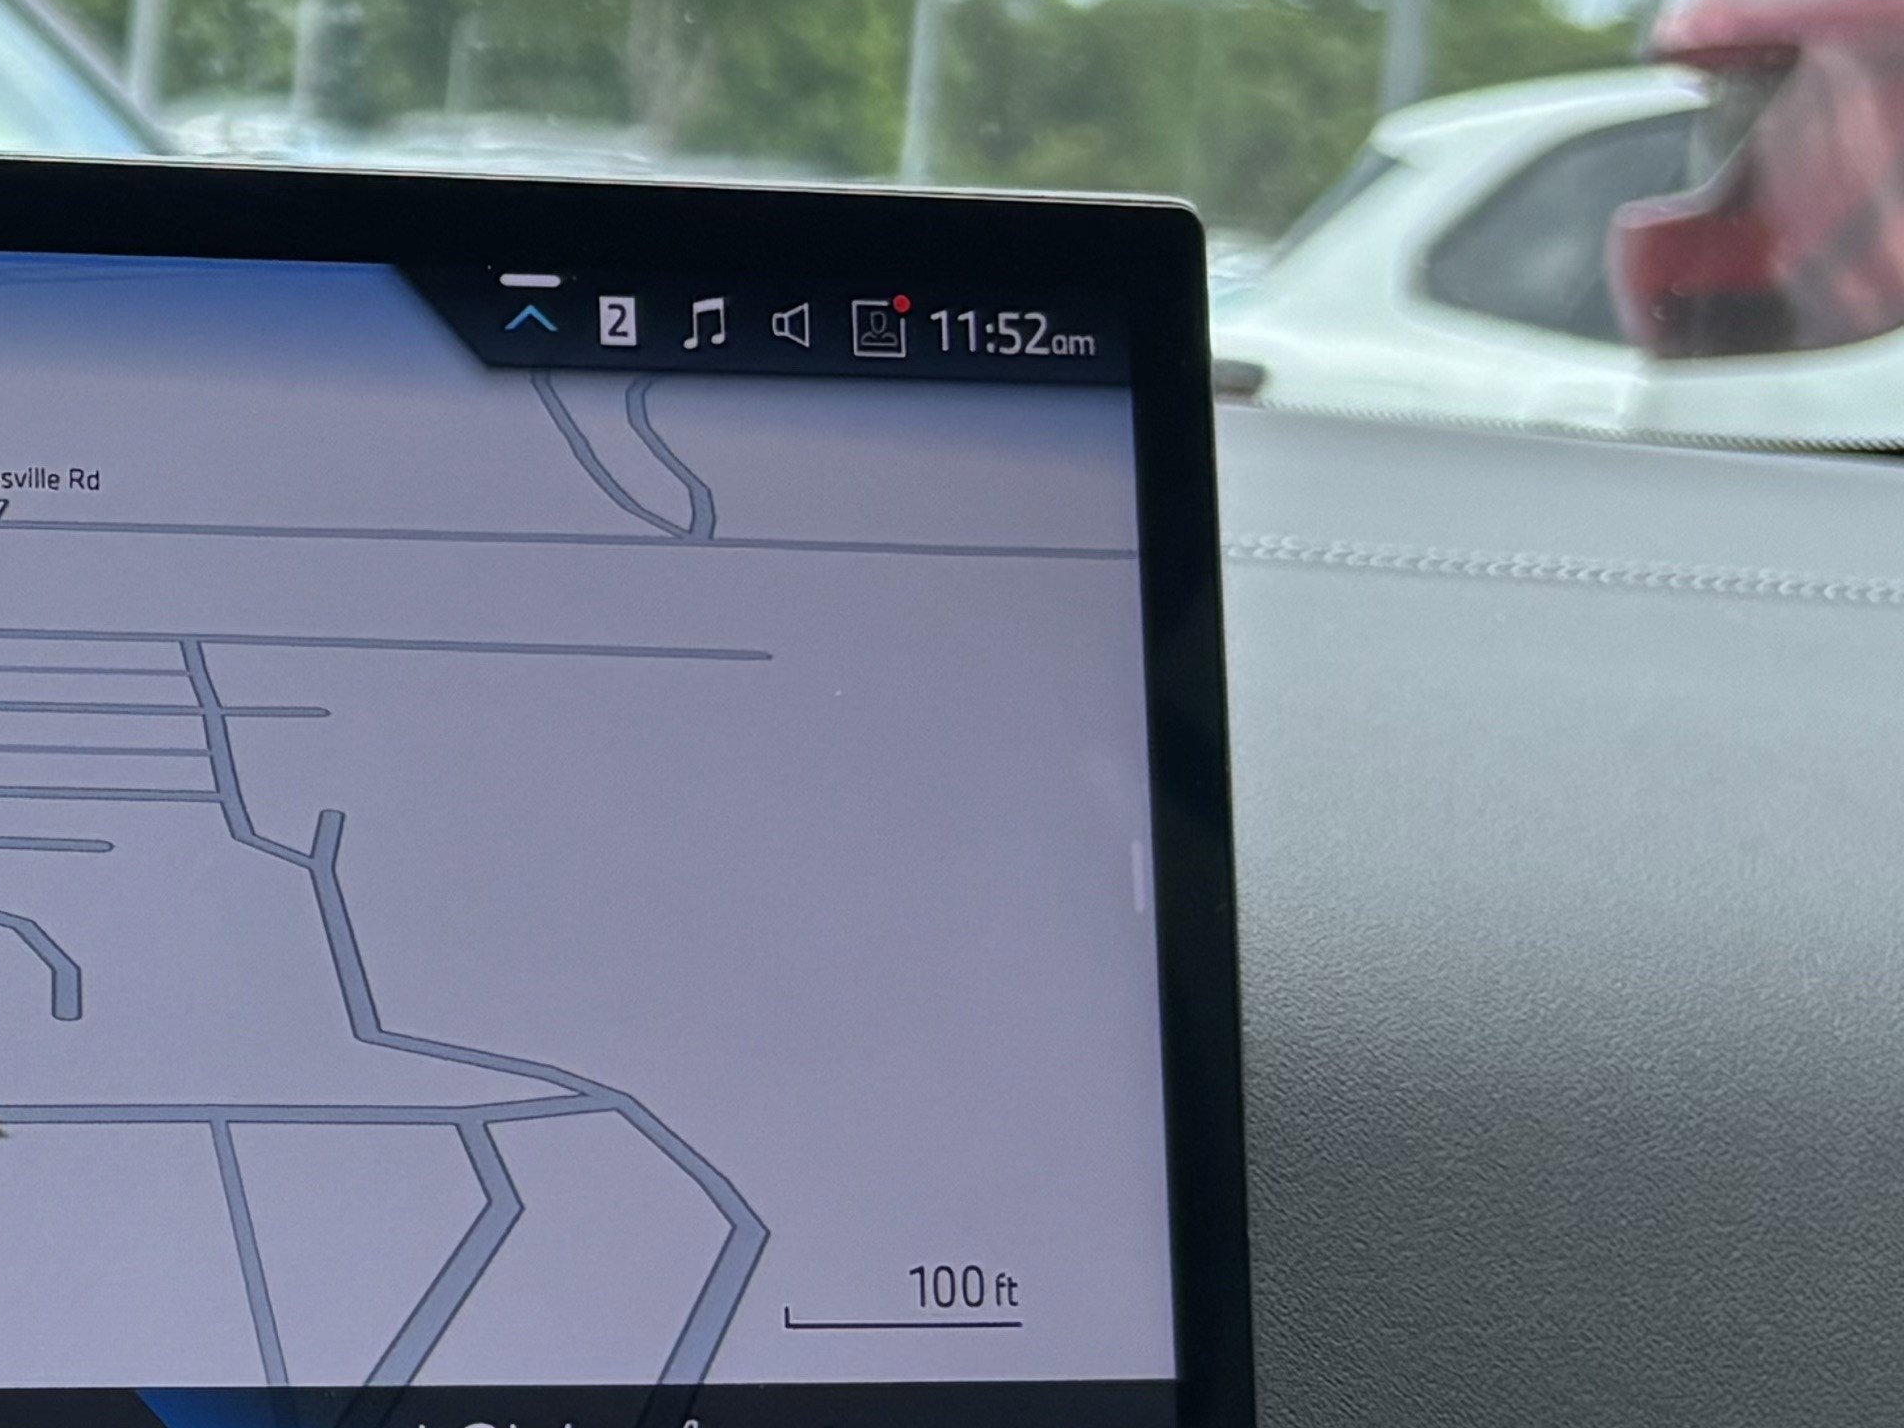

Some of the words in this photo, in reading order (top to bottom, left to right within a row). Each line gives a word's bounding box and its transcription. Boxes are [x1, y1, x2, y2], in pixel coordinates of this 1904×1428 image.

[606, 303, 629, 338] 2
[68, 467, 100, 491] Rd
[908, 1264, 985, 1308] 100
[995, 1272, 1019, 1307] ft
